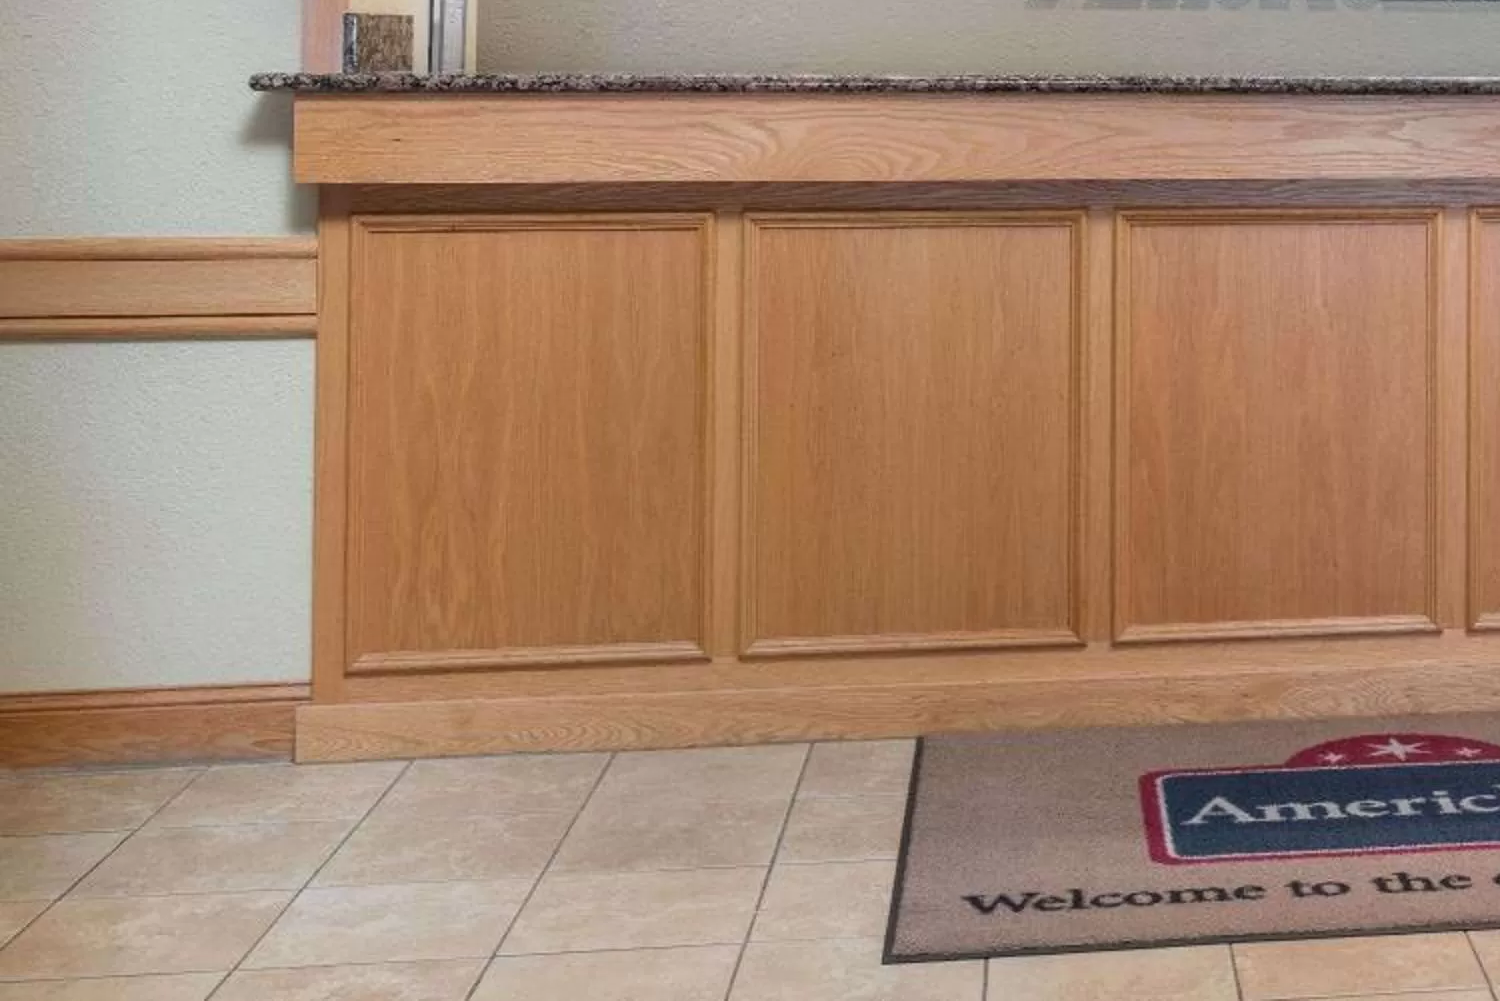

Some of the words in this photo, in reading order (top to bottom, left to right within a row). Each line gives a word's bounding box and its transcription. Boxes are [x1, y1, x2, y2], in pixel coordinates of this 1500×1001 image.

[960, 883, 1267, 915] Welcome
[1285, 879, 1351, 898] to
[1369, 872, 1474, 894] the
